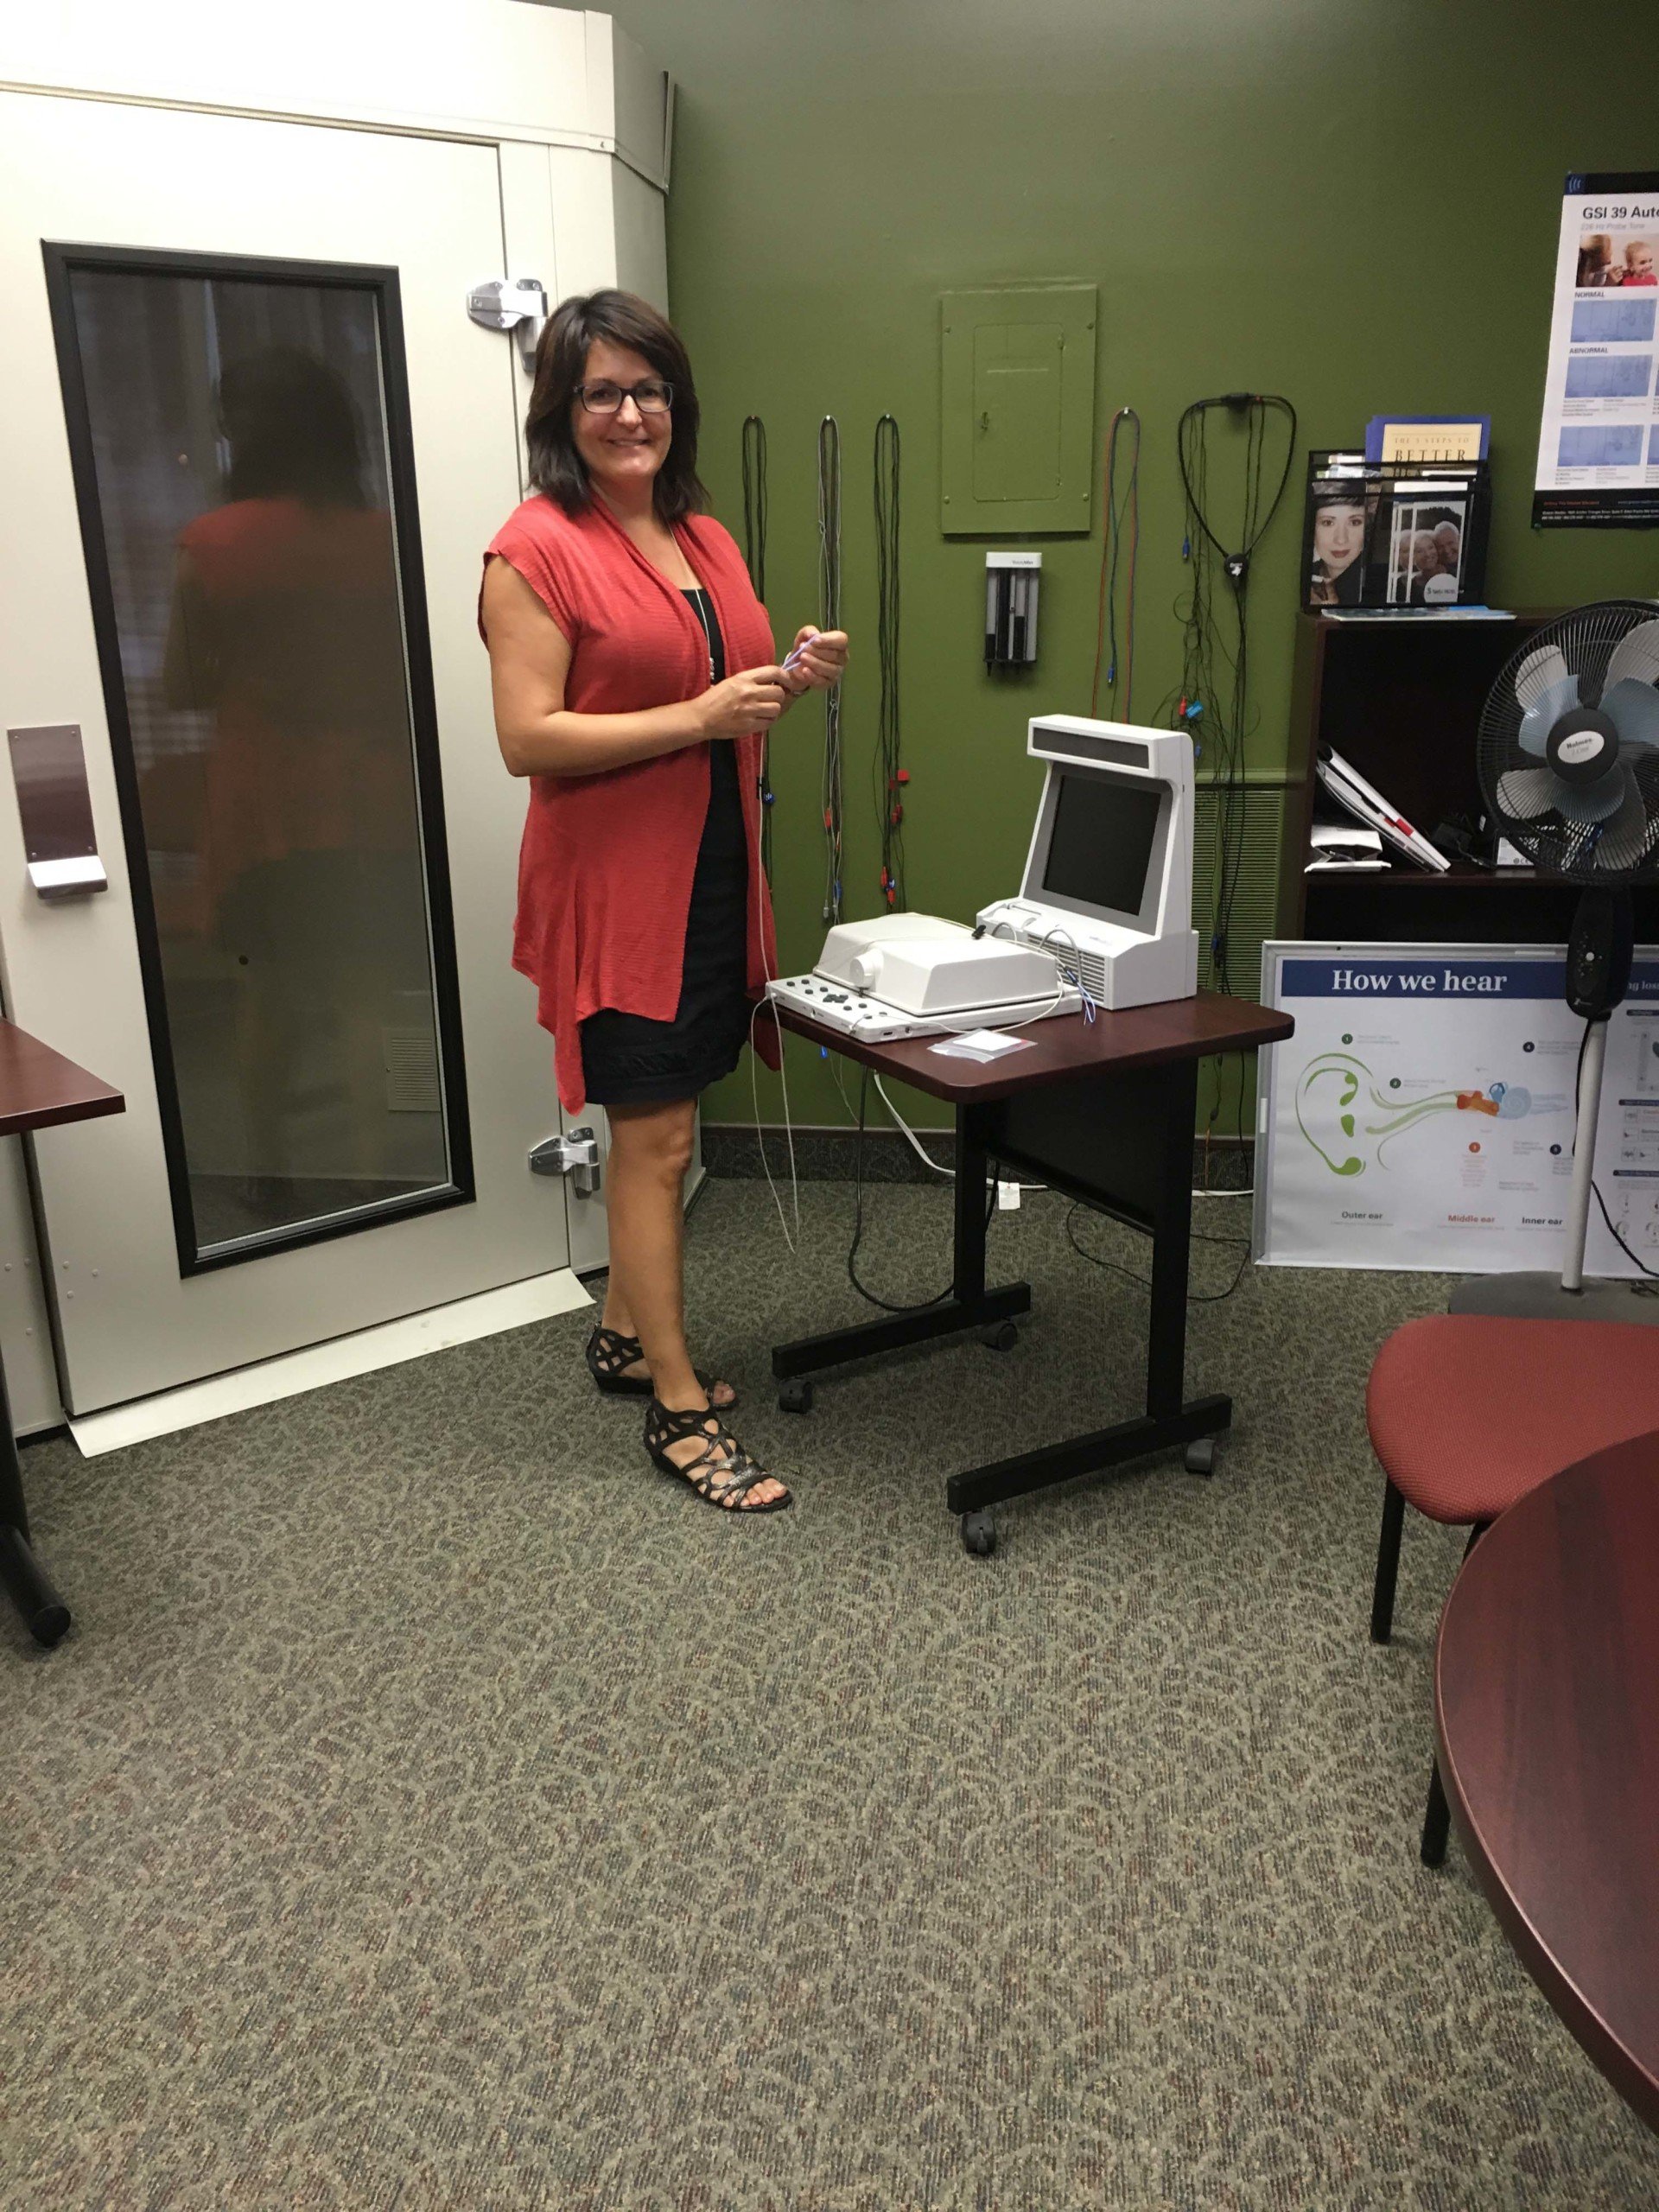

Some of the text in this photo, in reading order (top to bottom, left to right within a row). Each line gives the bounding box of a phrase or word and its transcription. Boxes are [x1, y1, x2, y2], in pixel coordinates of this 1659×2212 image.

[1583, 206, 1607, 219] GSI
[1611, 207, 1627, 219] 39
[1395, 449, 1465, 461] BETTER
[1332, 969, 1507, 992] How we hear
[1341, 1211, 1367, 1219] Outer
[1447, 1214, 1478, 1223] Middle
